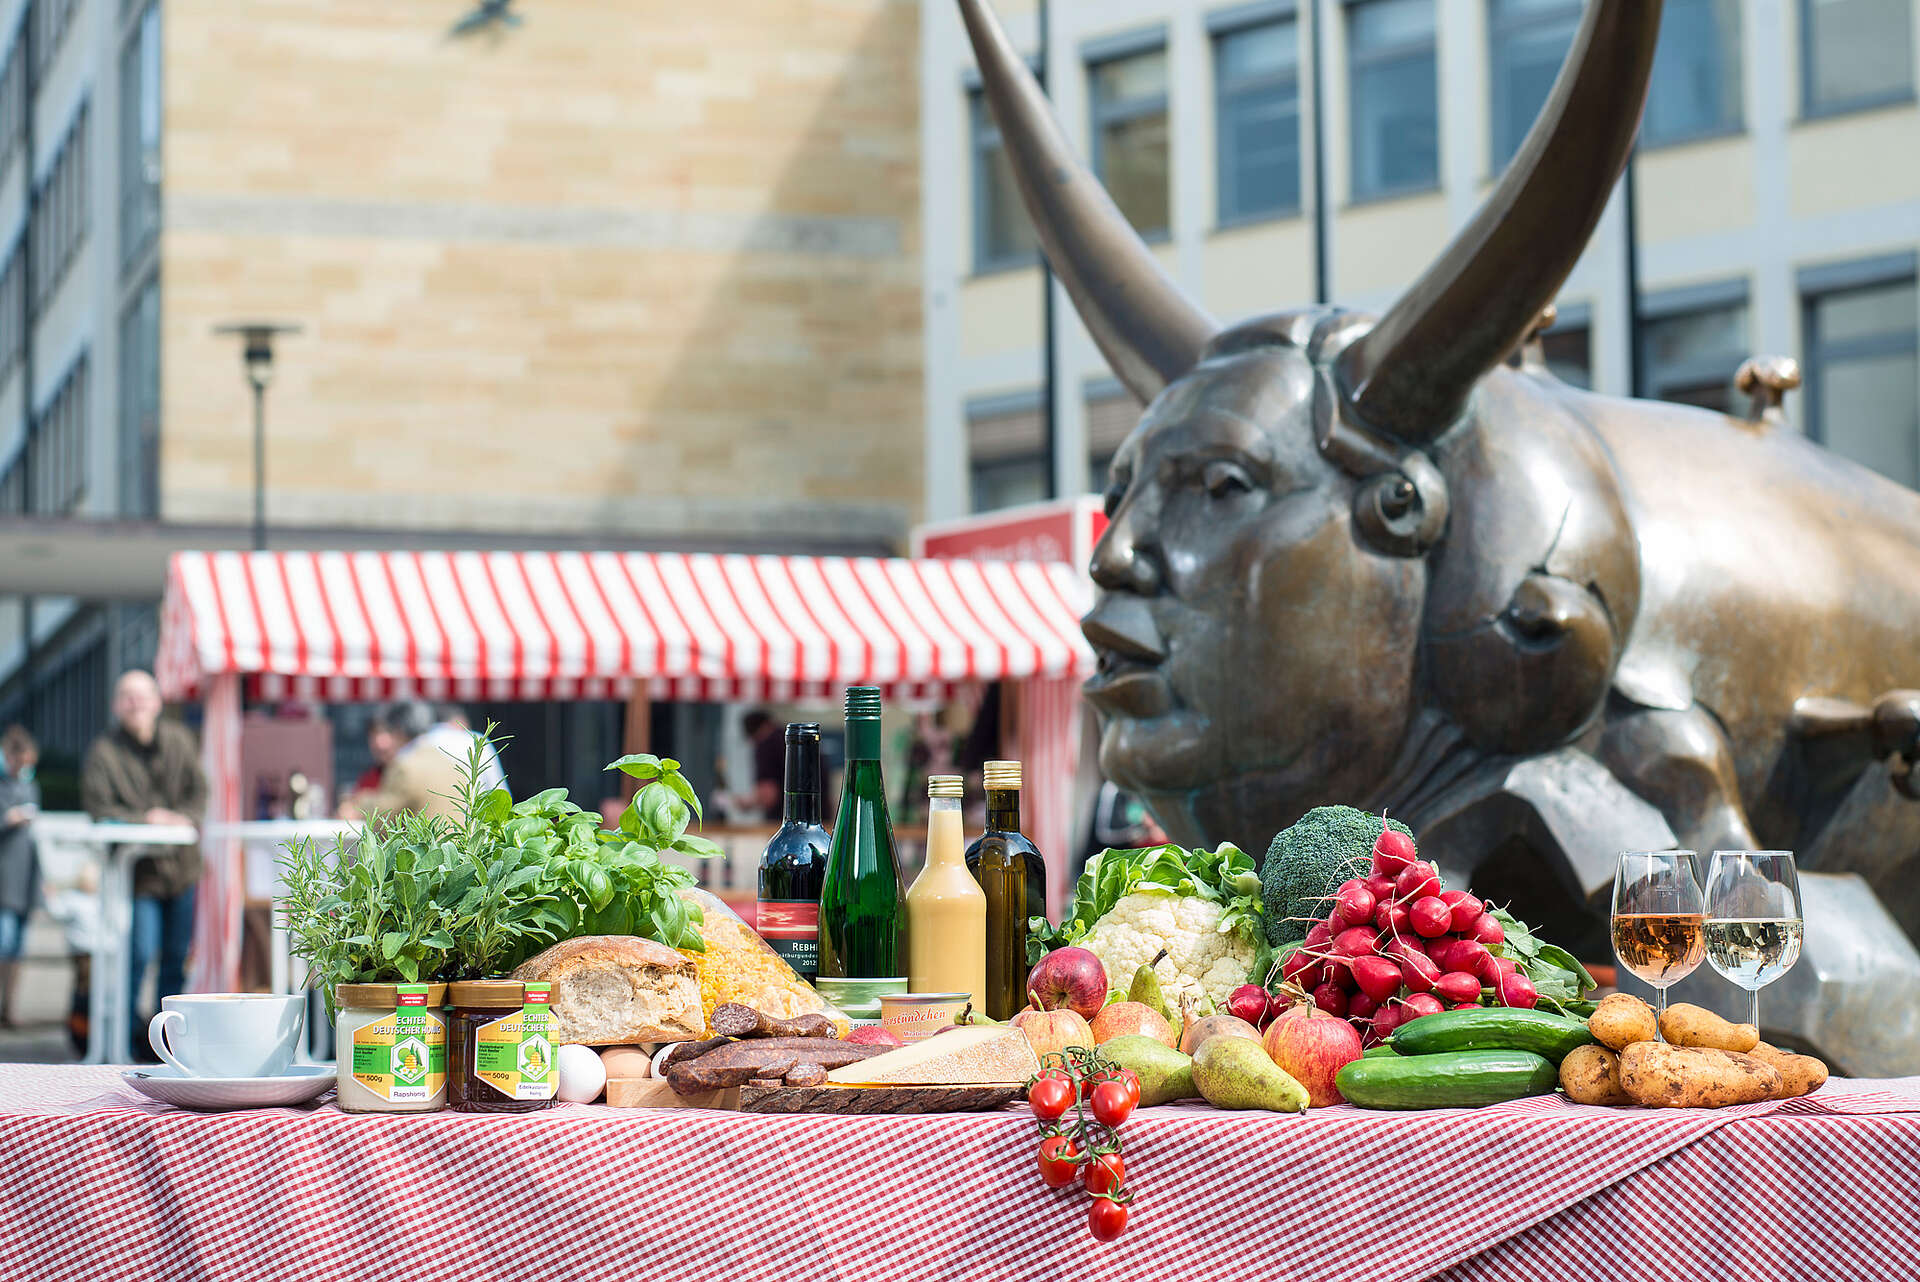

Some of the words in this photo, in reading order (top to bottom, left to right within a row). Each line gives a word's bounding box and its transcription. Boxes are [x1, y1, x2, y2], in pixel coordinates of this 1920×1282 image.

[396, 1016, 426, 1025] ECHTER
[523, 1014, 549, 1022] ECHTER
[373, 1025, 421, 1035] DEUTSCHER
[500, 1023, 544, 1032] DEUTSCHER
[366, 1074, 383, 1083] 500g
[492, 1072, 510, 1080] 500g
[393, 1090, 426, 1098] Rapshonig
